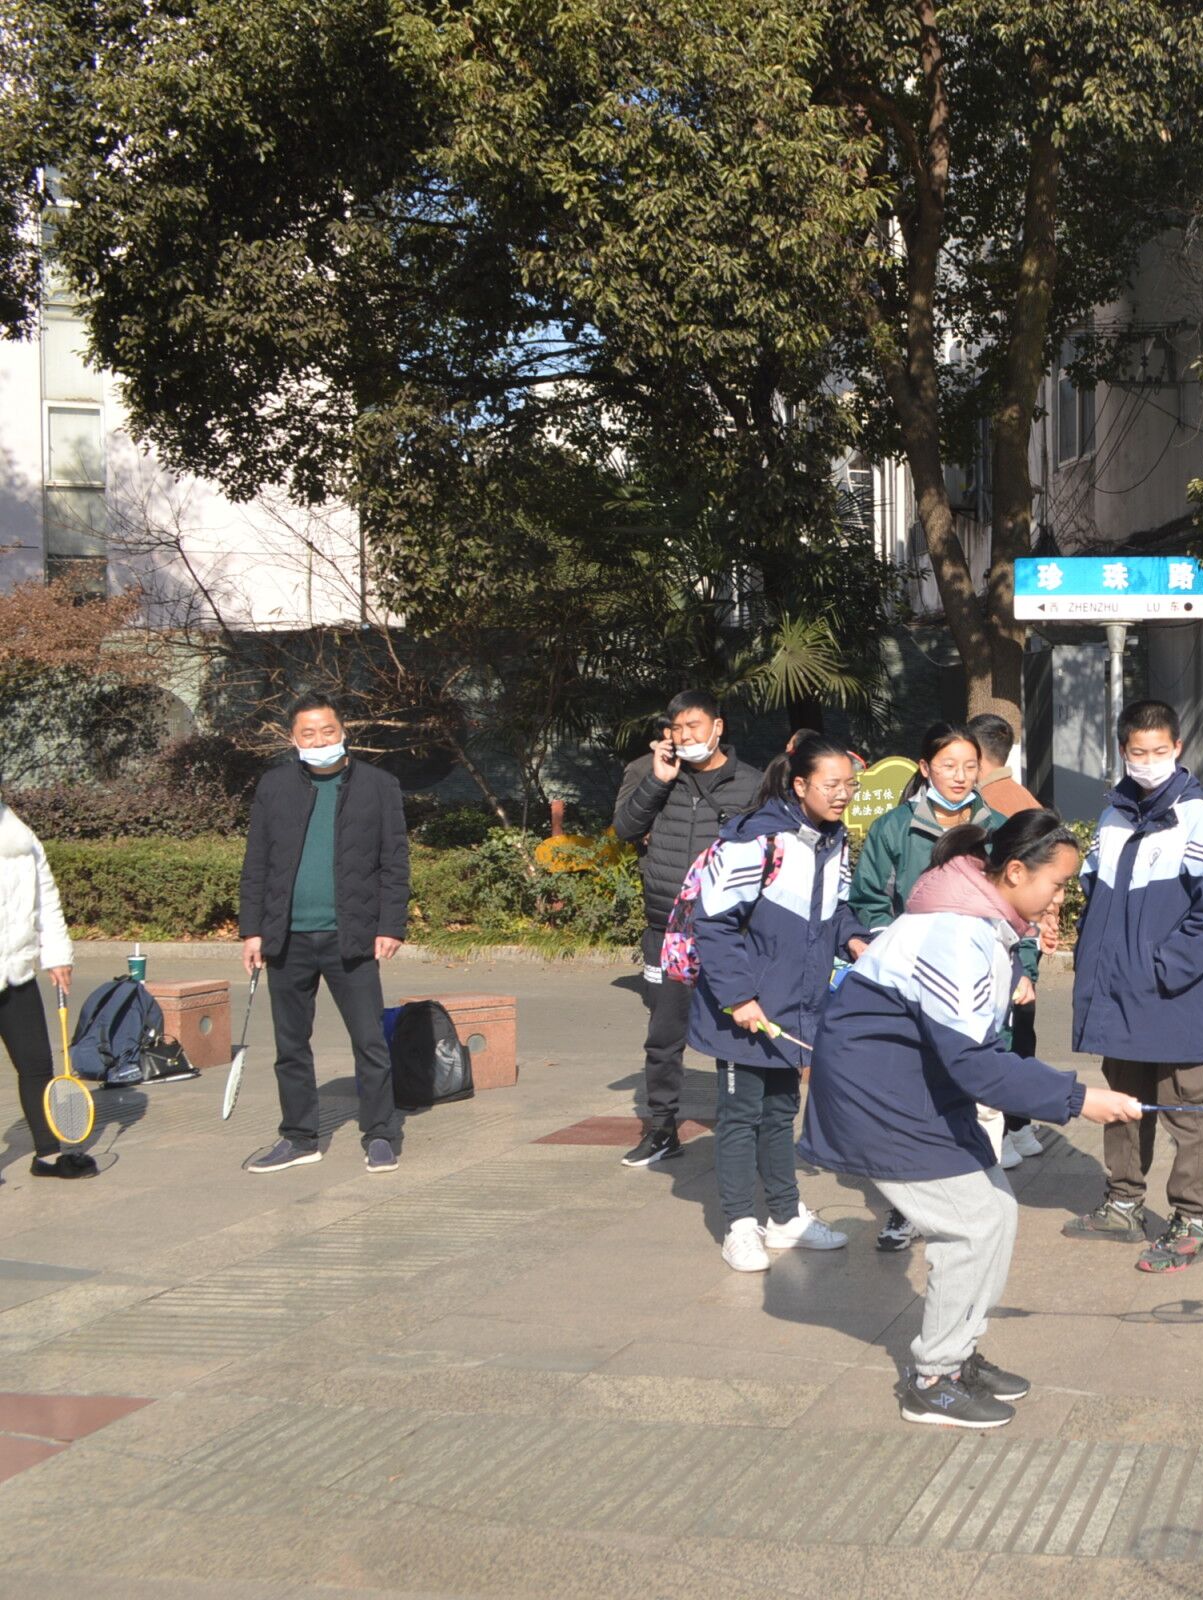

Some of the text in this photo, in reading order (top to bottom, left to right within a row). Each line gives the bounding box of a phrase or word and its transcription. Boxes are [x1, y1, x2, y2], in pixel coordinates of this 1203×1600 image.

[1037, 562, 1195, 590] 珍珠路
[1068, 602, 1160, 612] ZHENZHU LU
